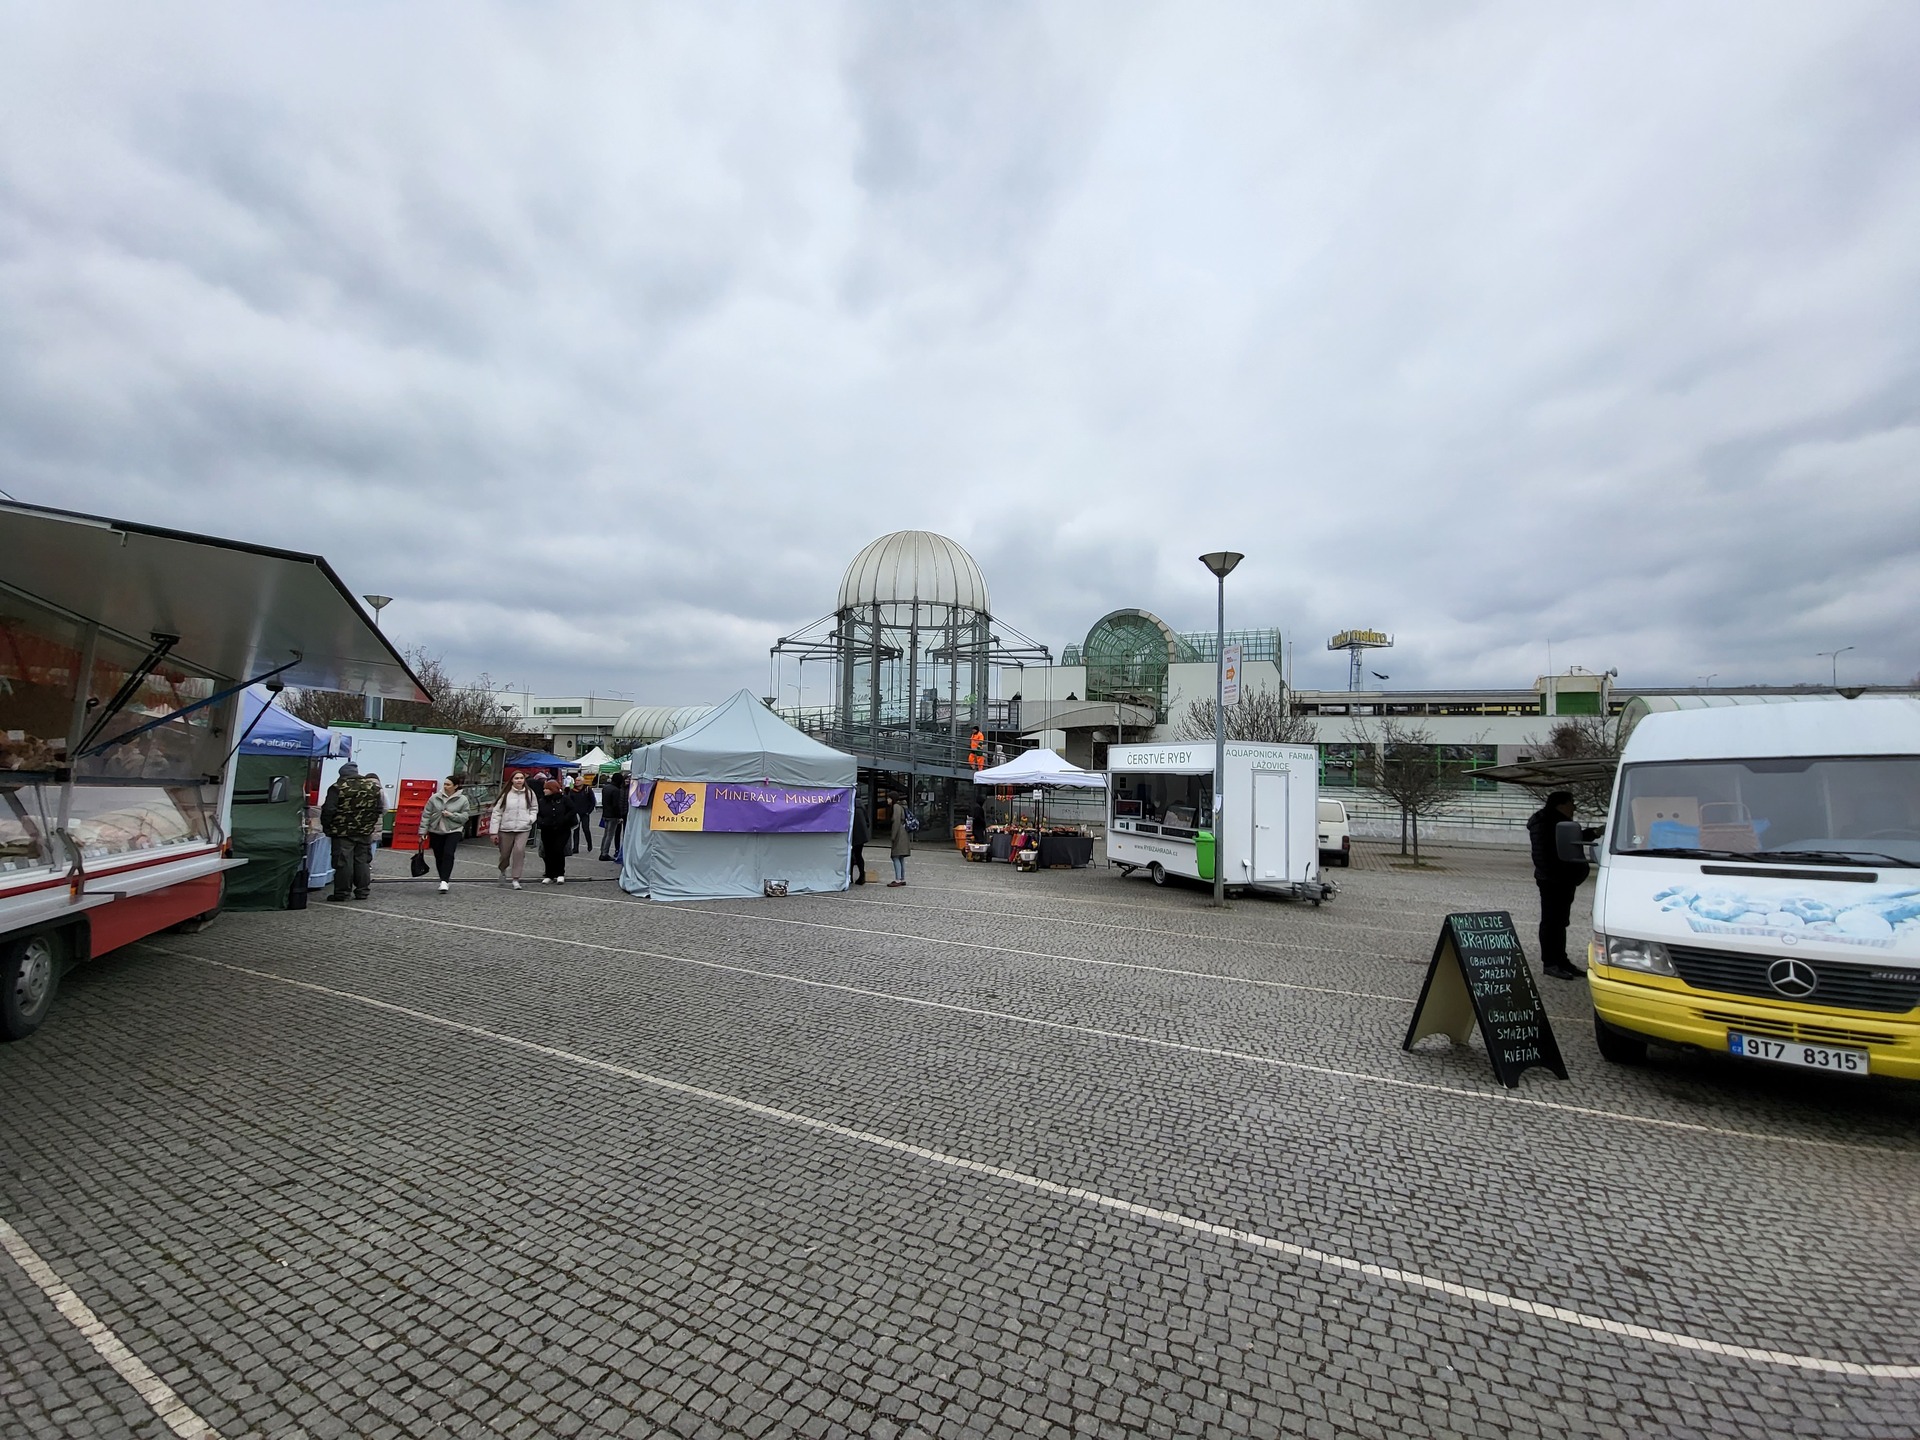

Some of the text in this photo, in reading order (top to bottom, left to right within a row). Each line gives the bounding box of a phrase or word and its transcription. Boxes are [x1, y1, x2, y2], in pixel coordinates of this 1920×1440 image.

[1351, 628, 1387, 644] makro
[1127, 750, 1192, 765] ČERSTVÉ RYBY
[1288, 751, 1314, 761] FARMA
[1478, 916, 1504, 928] VEJCE
[1460, 931, 1520, 950] BRAMBORÁK
[1732, 1045, 1742, 1053] CZ
[1747, 1039, 1857, 1070] 9T7 8315
